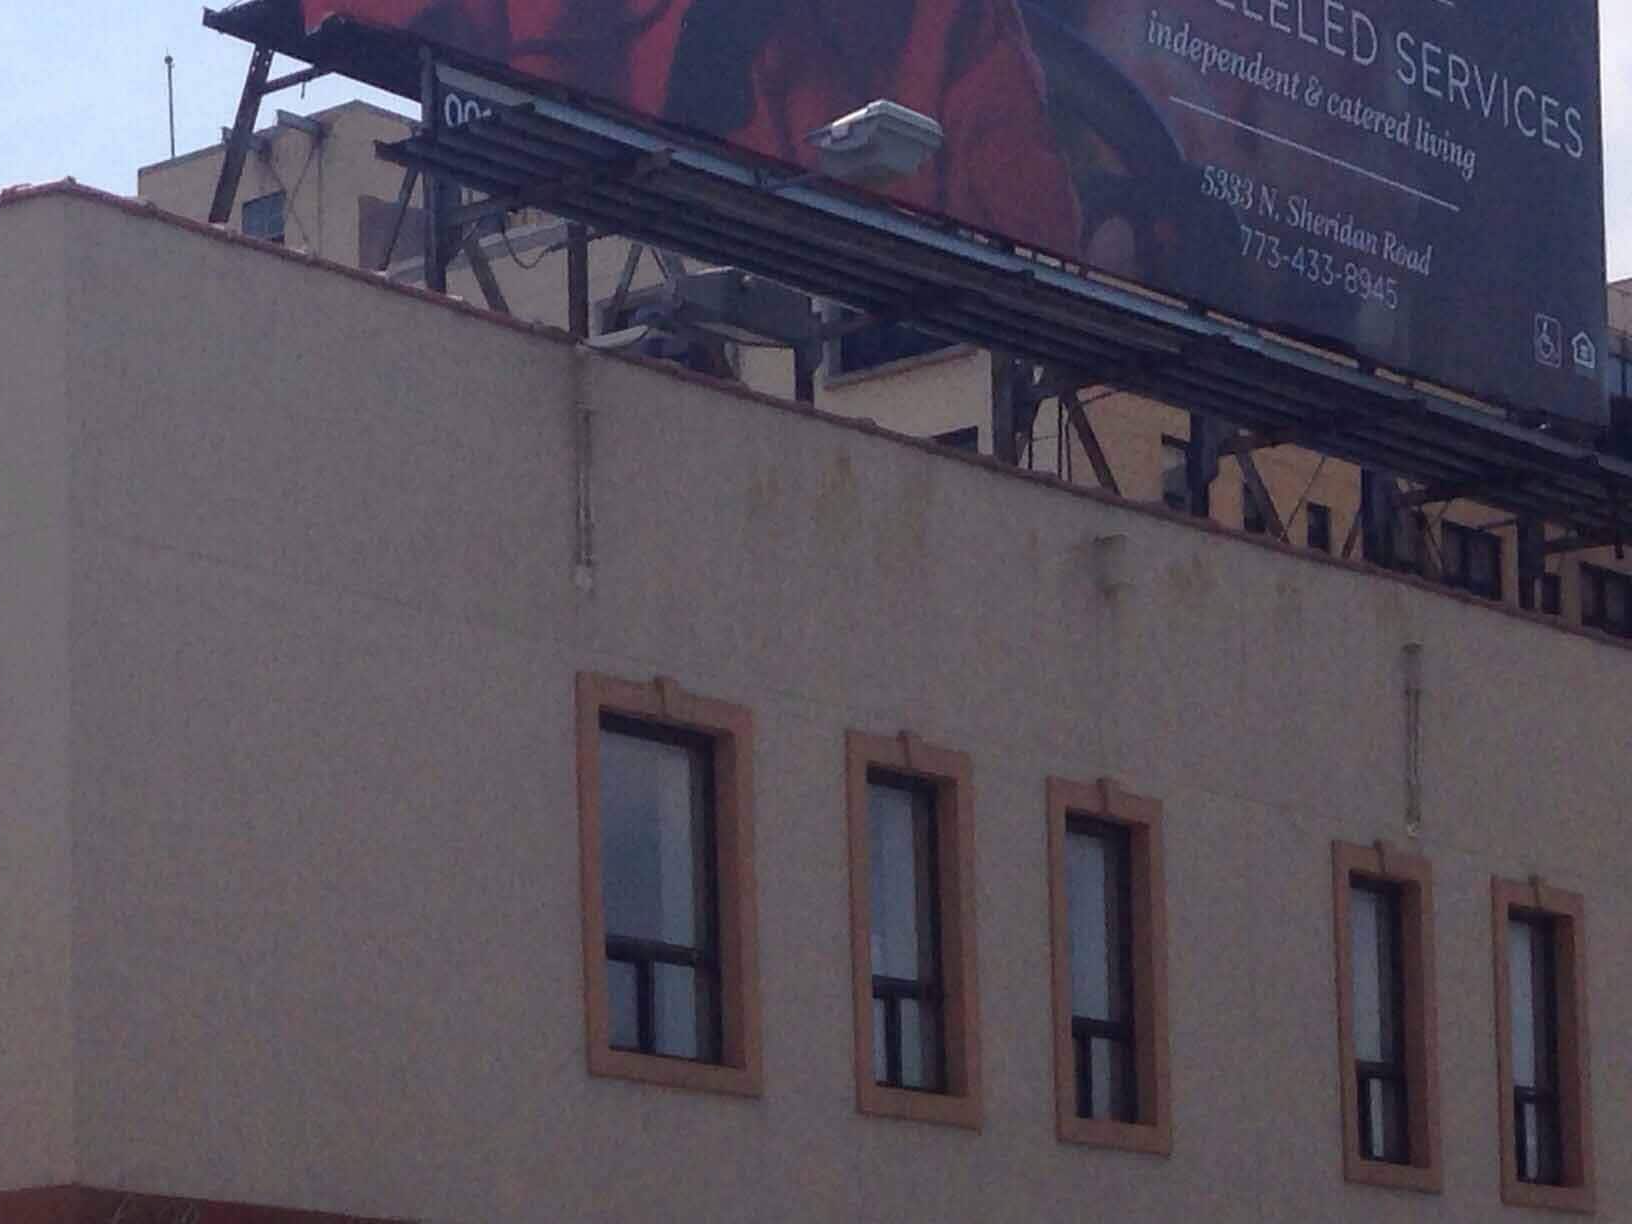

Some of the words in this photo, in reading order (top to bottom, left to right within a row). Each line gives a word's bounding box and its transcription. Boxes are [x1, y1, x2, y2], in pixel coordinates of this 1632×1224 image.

[1147, 10, 1301, 101] independent
[1304, 75, 1323, 107] &
[1326, 92, 1411, 145] catered
[1416, 117, 1477, 182] living
[1396, 31, 1584, 158] SERVICES
[1257, 183, 1281, 223] N.
[1286, 194, 1378, 256] Sheridan
[1382, 230, 1434, 277] Road
